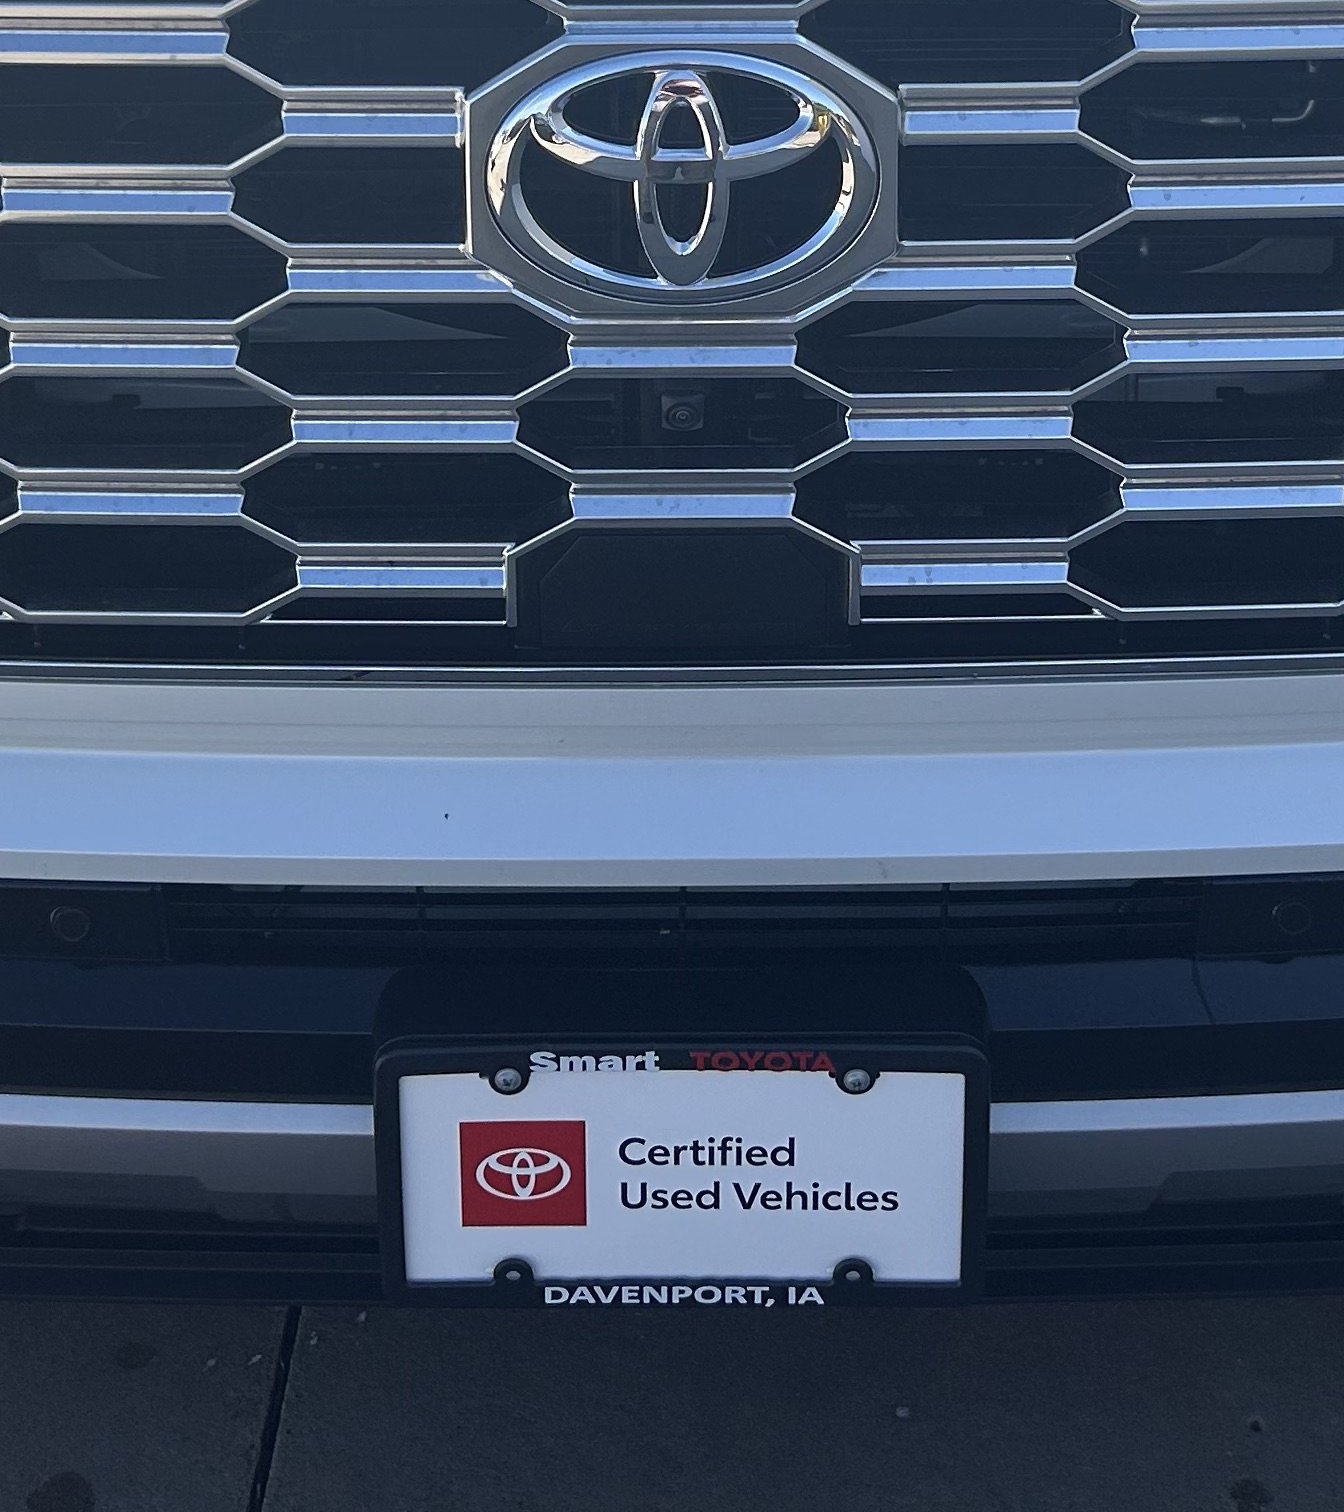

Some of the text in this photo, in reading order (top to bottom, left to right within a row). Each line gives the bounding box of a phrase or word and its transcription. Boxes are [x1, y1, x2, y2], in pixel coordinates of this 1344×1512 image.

[529, 1049, 837, 1073] Smart TOYOTA
[618, 1135, 796, 1167] Certified
[620, 1182, 900, 1211] Used Vehicles
[544, 1285, 824, 1308] DAVENPORT, IA
